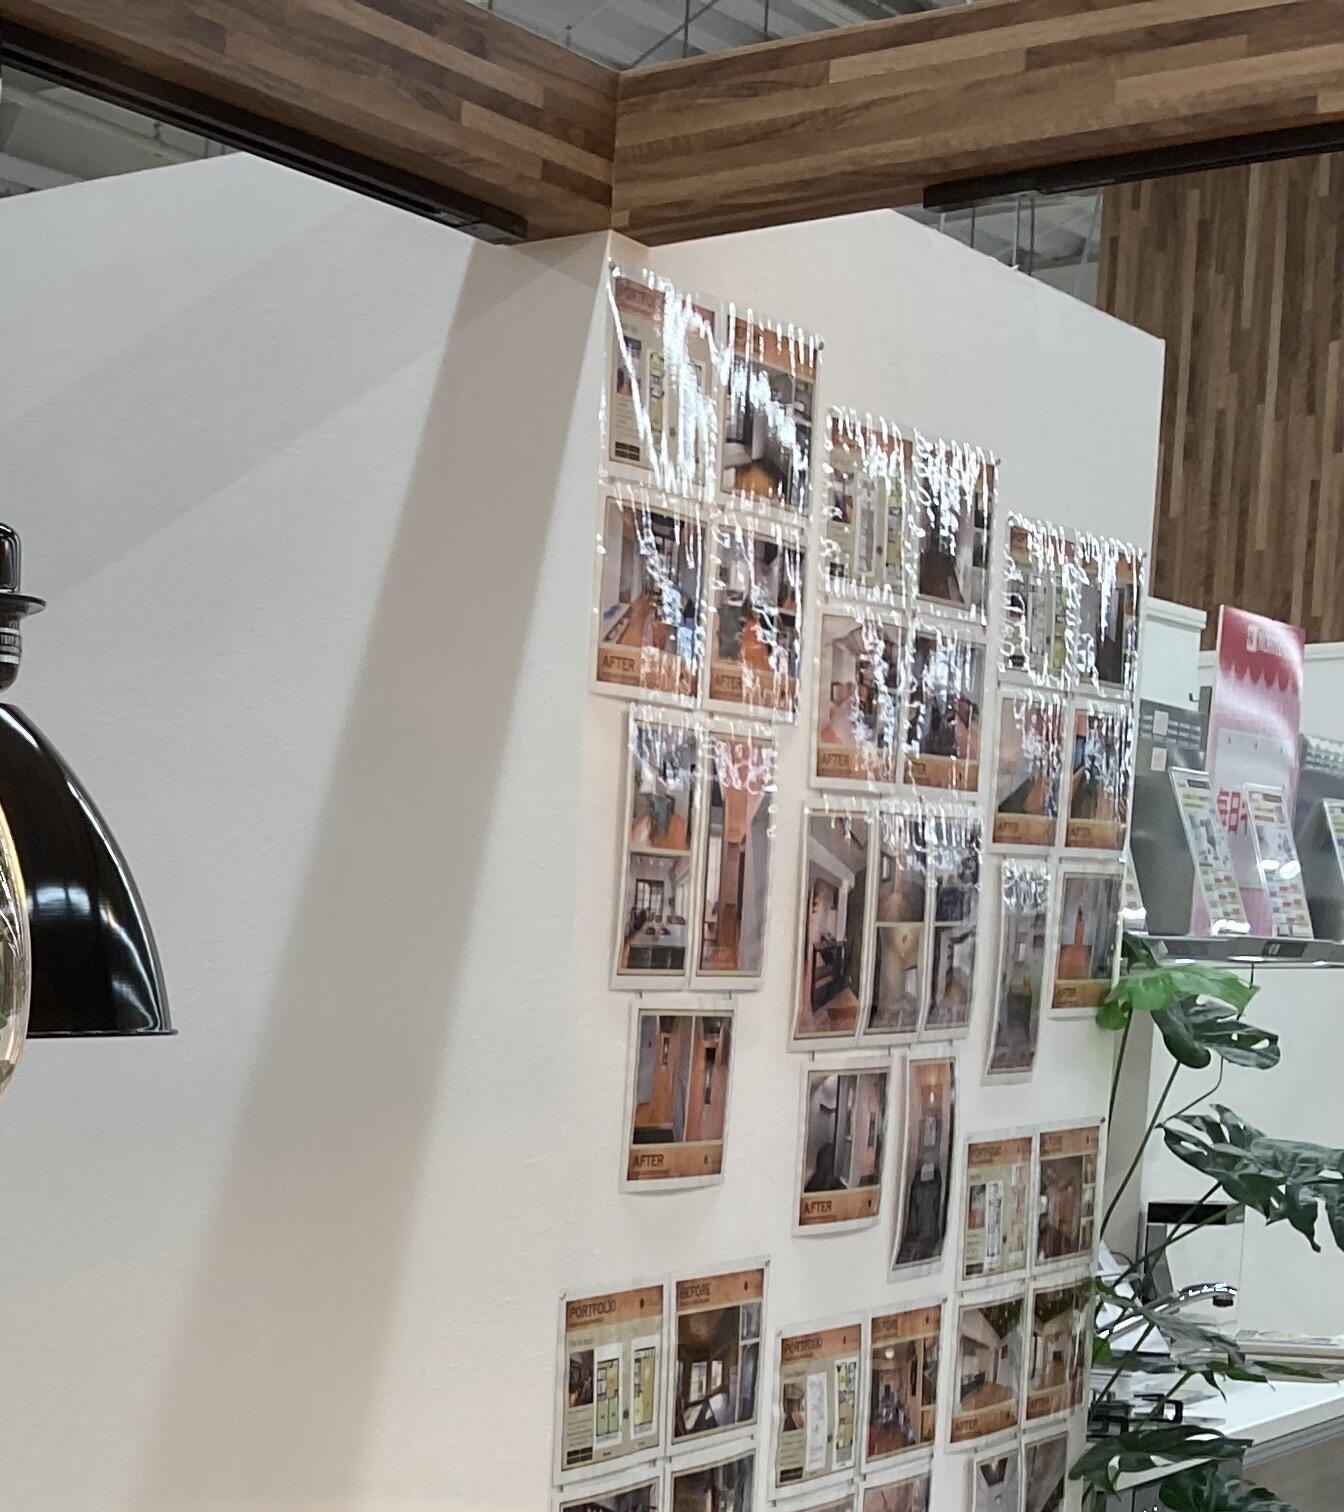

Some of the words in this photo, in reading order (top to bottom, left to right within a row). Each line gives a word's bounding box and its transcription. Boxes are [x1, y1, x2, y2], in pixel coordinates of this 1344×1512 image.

[601, 655, 636, 672] AFTER
[821, 753, 849, 766] AFTER
[632, 1153, 664, 1168] AFTER
[803, 1200, 832, 1215] AFTER
[568, 1298, 617, 1319] PORTFOLIO
